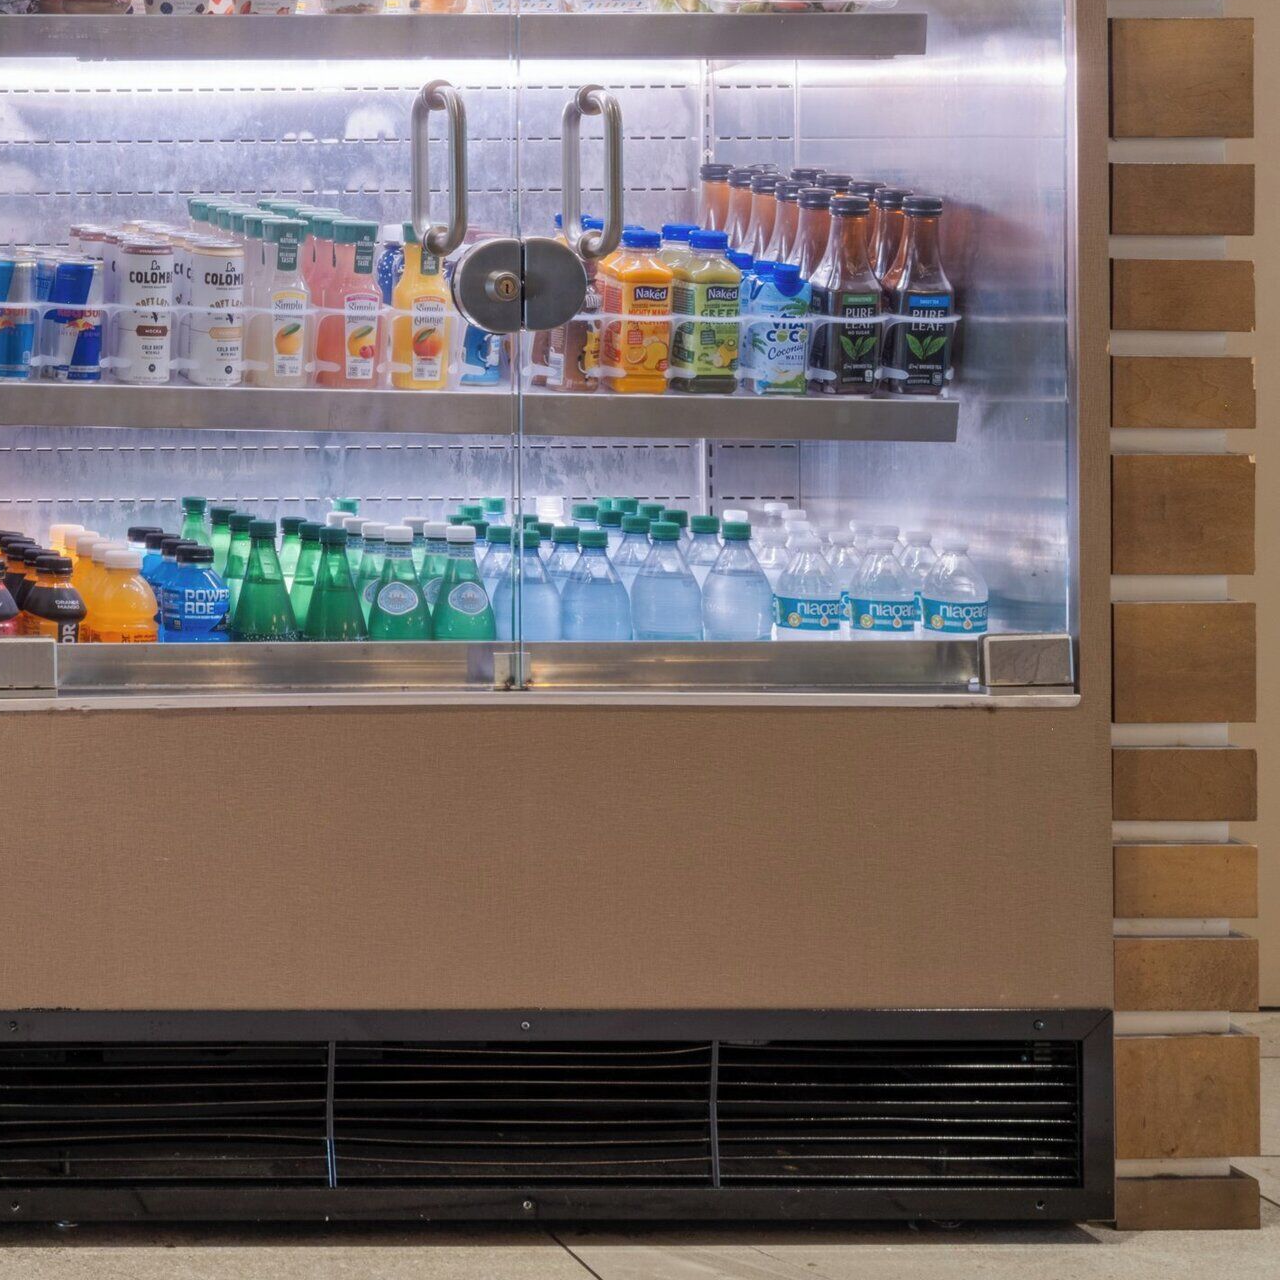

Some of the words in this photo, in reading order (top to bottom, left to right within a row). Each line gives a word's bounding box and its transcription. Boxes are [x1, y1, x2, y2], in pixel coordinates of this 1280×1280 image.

[150, 259, 161, 271] La
[225, 261, 236, 273] La
[635, 288, 667, 299] Naked
[708, 288, 738, 299] Naked
